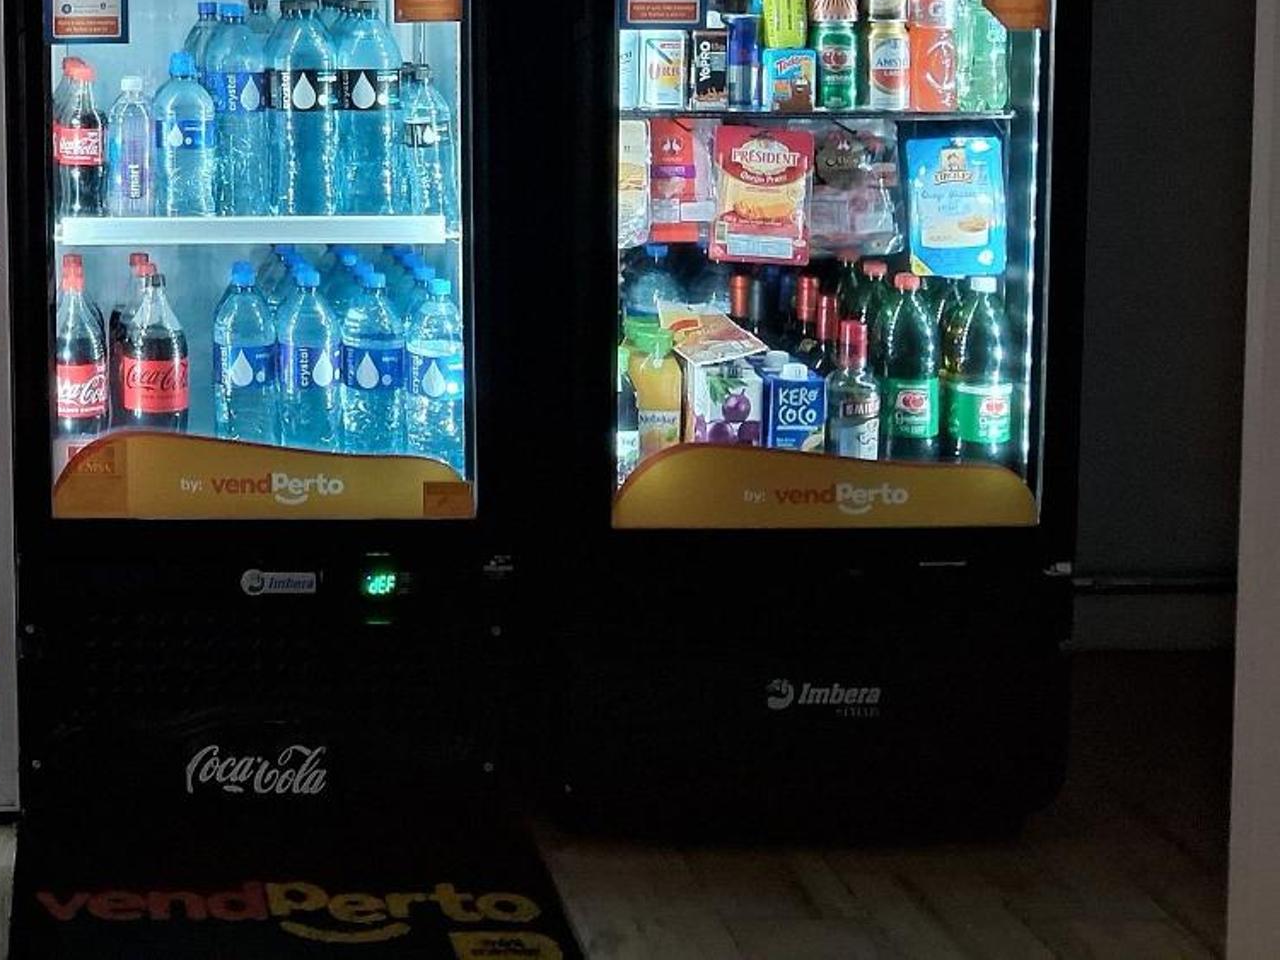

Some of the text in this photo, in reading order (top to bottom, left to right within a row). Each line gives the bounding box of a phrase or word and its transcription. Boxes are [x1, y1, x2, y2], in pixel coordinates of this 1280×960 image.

[779, 387, 820, 406] KERO
[779, 406, 818, 426] COCO
[213, 472, 345, 505] vendPerto
[774, 482, 910, 506] vendPerto
[798, 682, 882, 705] Imbera
[184, 743, 329, 797] Coca-Cola
[35, 879, 543, 924] vendPerto
